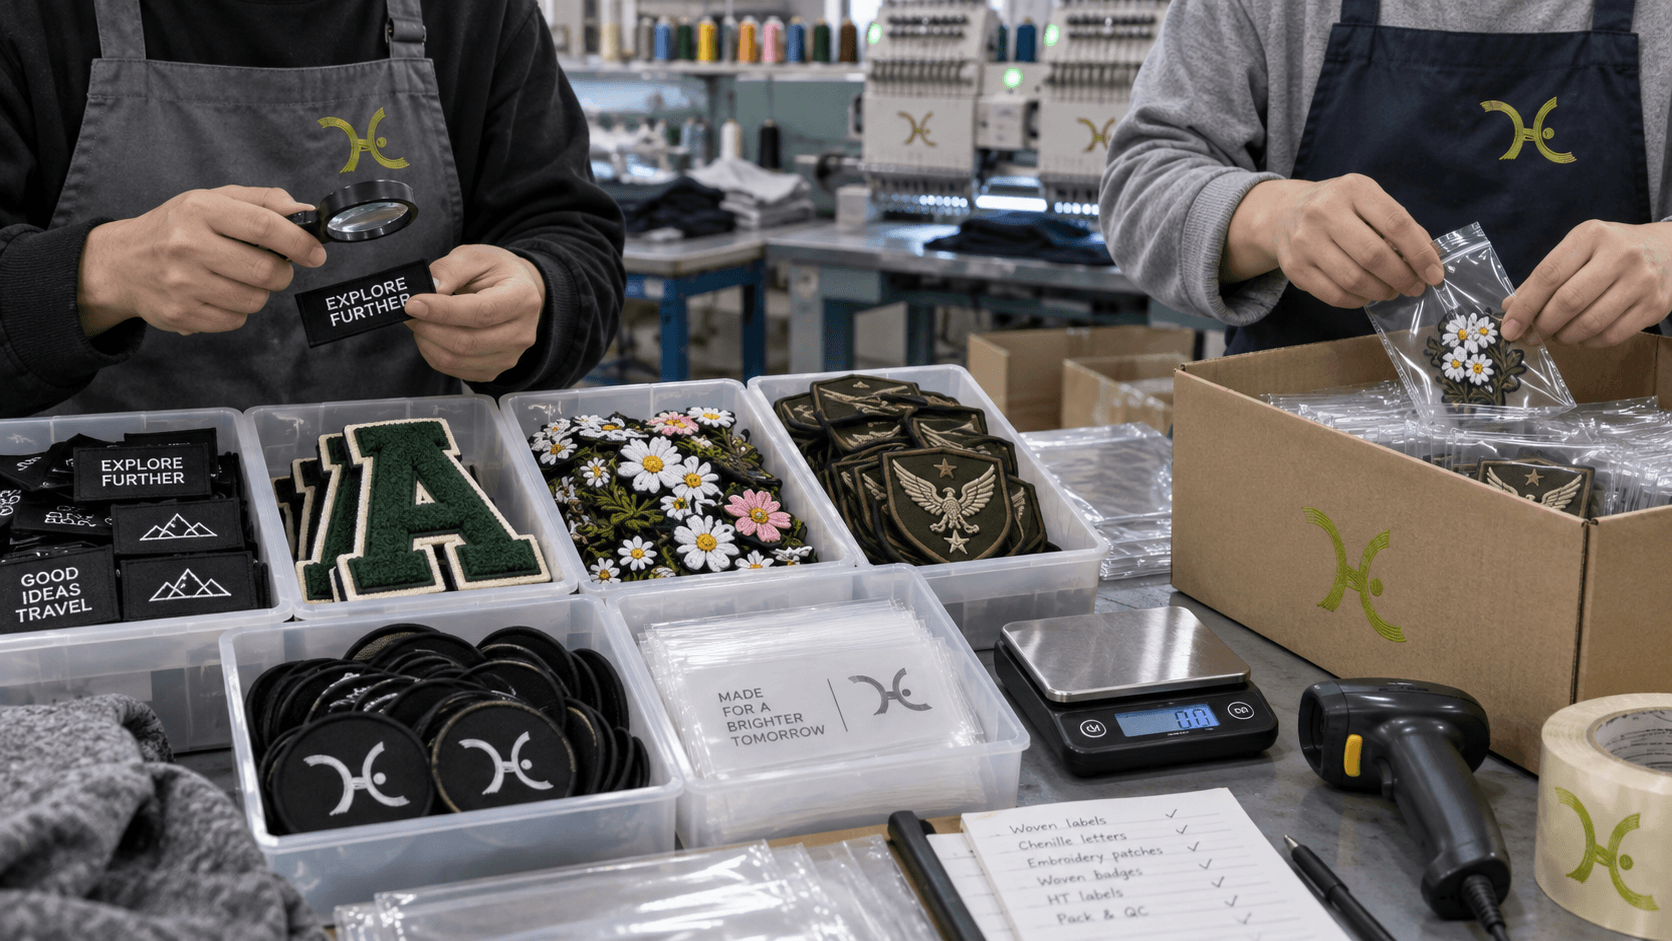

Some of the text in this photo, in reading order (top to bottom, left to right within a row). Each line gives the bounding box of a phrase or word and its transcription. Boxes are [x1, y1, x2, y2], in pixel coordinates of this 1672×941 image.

[325, 277, 408, 311] EXPLORE
[330, 293, 411, 327] FURTHER
[101, 457, 183, 472] EXPLORE
[102, 472, 185, 487] FURTHER
[337, 417, 552, 602] A
[21, 567, 79, 587] GOOD
[22, 583, 81, 605] IDEAS
[15, 598, 93, 623] TRAVEL
[718, 688, 764, 703] MADE
[722, 702, 771, 717] FOR A
[726, 713, 804, 732] BRIGHTER
[730, 725, 825, 747] TOMORROW
[1009, 816, 1107, 834] Woven labels
[1018, 832, 1127, 850] Chenille letters
[1027, 847, 1163, 868] Embroidery patches
[1037, 867, 1143, 886] Woven badges
[1047, 887, 1124, 905] HT labels
[1057, 906, 1149, 925] Pack & QC
